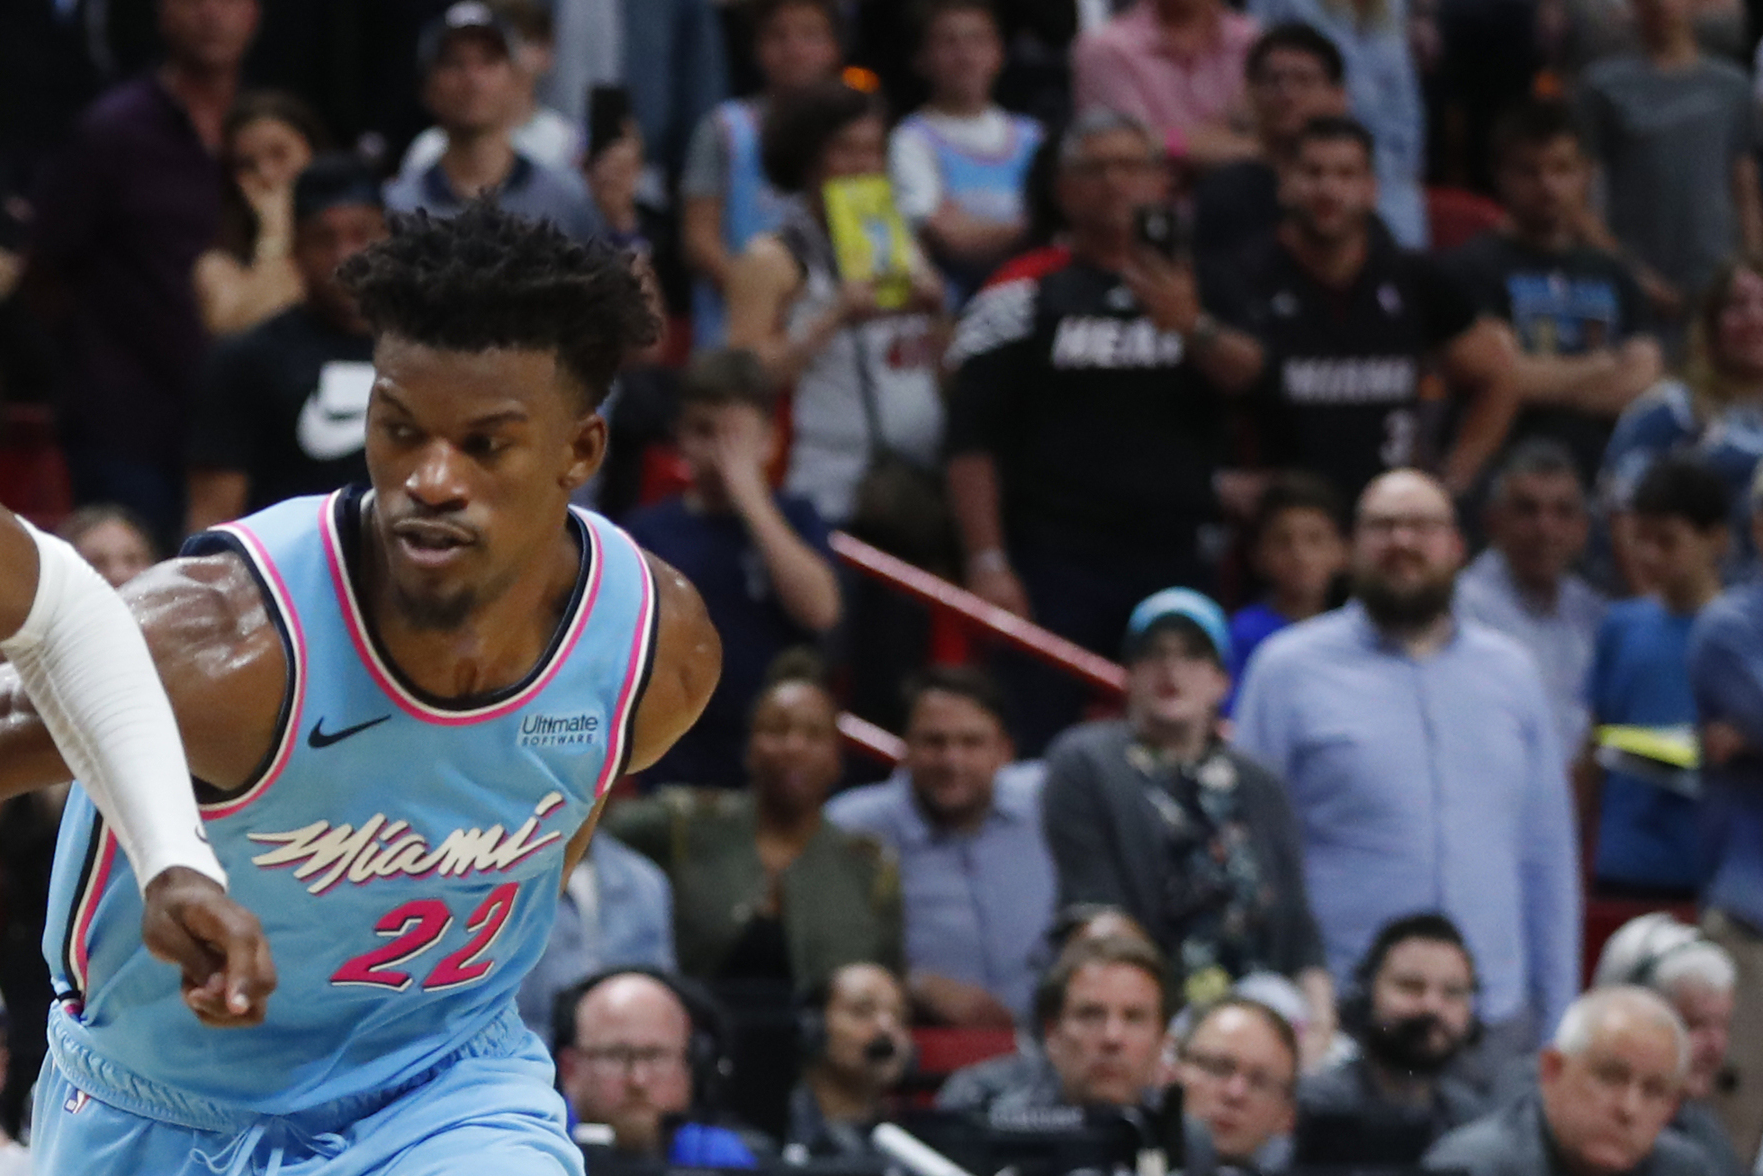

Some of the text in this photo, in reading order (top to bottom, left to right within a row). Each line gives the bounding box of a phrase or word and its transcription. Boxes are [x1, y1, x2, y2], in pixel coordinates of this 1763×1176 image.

[521, 734, 593, 747] SOFTWARE
[522, 714, 599, 735] Ultimate
[246, 791, 566, 897] Miami
[330, 881, 520, 992] 22
